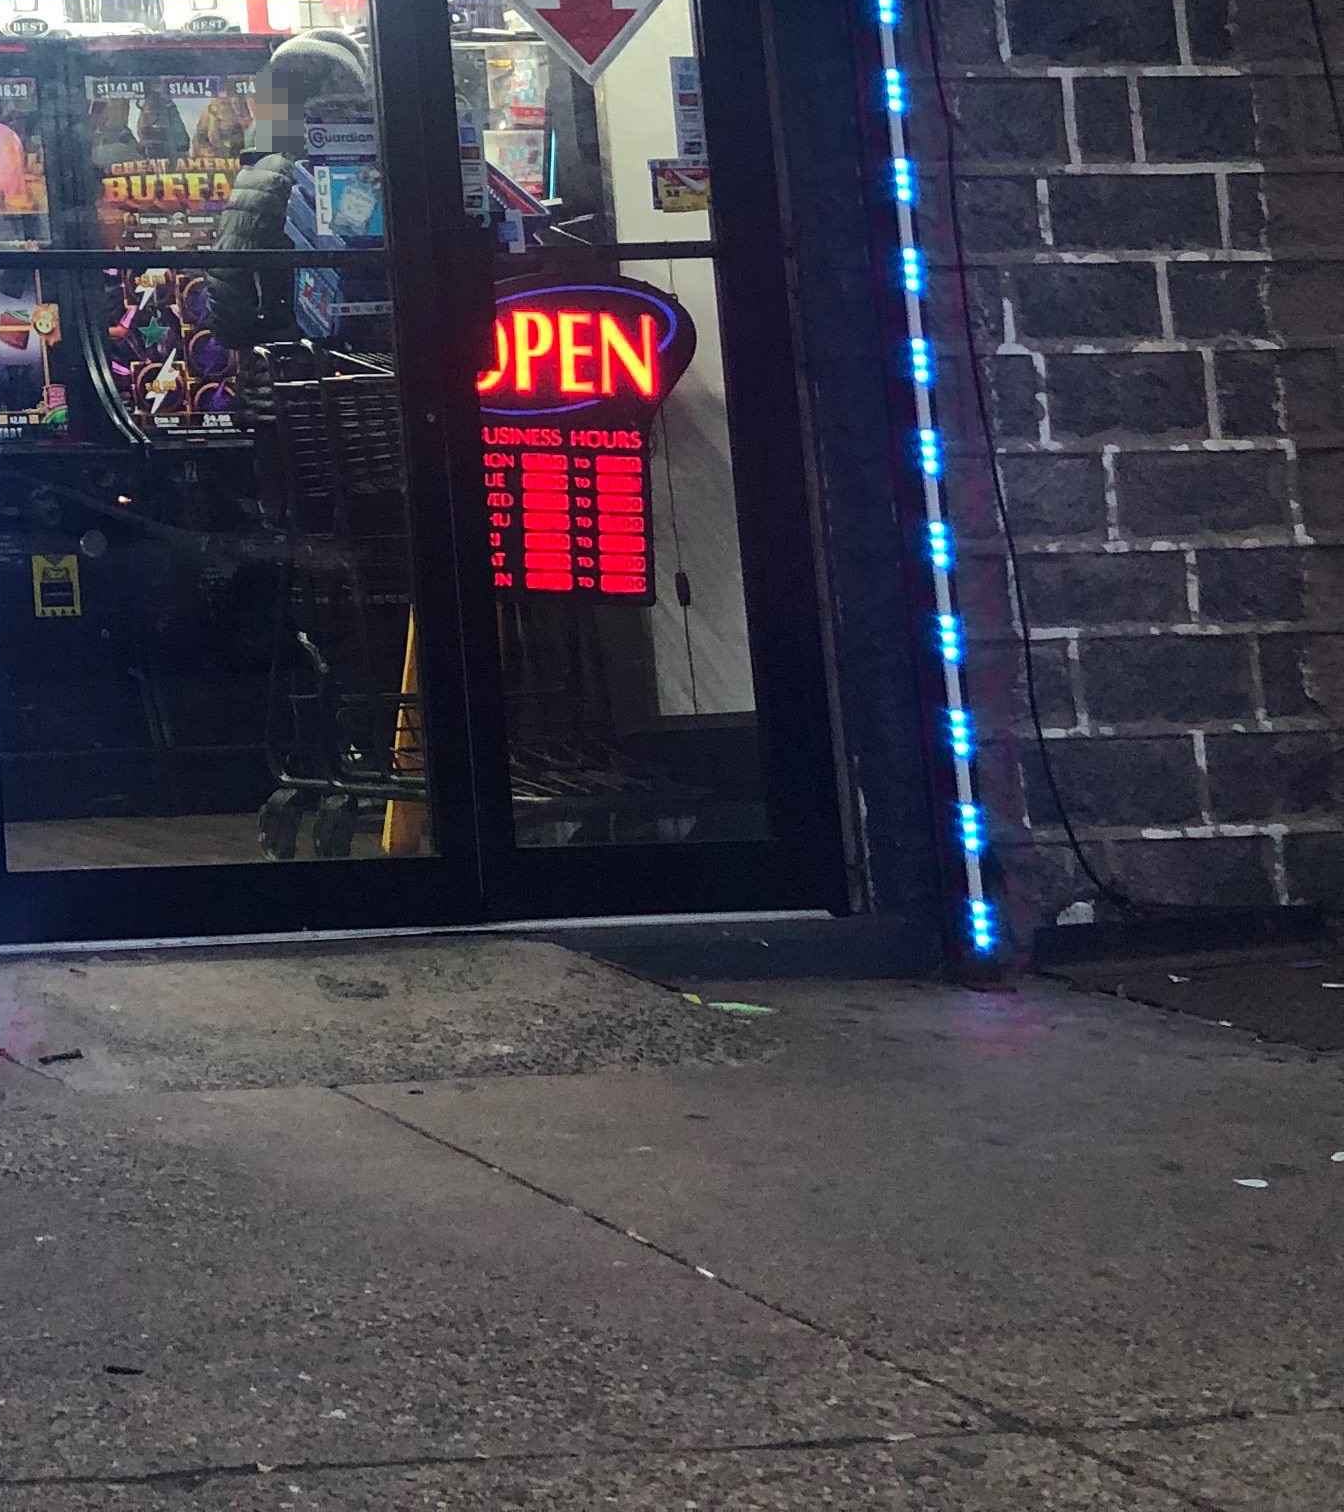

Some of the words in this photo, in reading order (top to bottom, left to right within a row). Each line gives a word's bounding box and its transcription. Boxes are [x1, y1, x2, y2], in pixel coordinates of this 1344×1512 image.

[12, 21, 46, 33] BEST
[191, 19, 224, 31] BEST
[309, 128, 374, 148] Guardian
[111, 158, 169, 175] GREAT
[101, 172, 235, 202] BUFFA
[316, 169, 330, 225] PULL
[482, 426, 562, 447] USINESS
[570, 430, 643, 450] HOURS
[484, 472, 506, 488] UE
